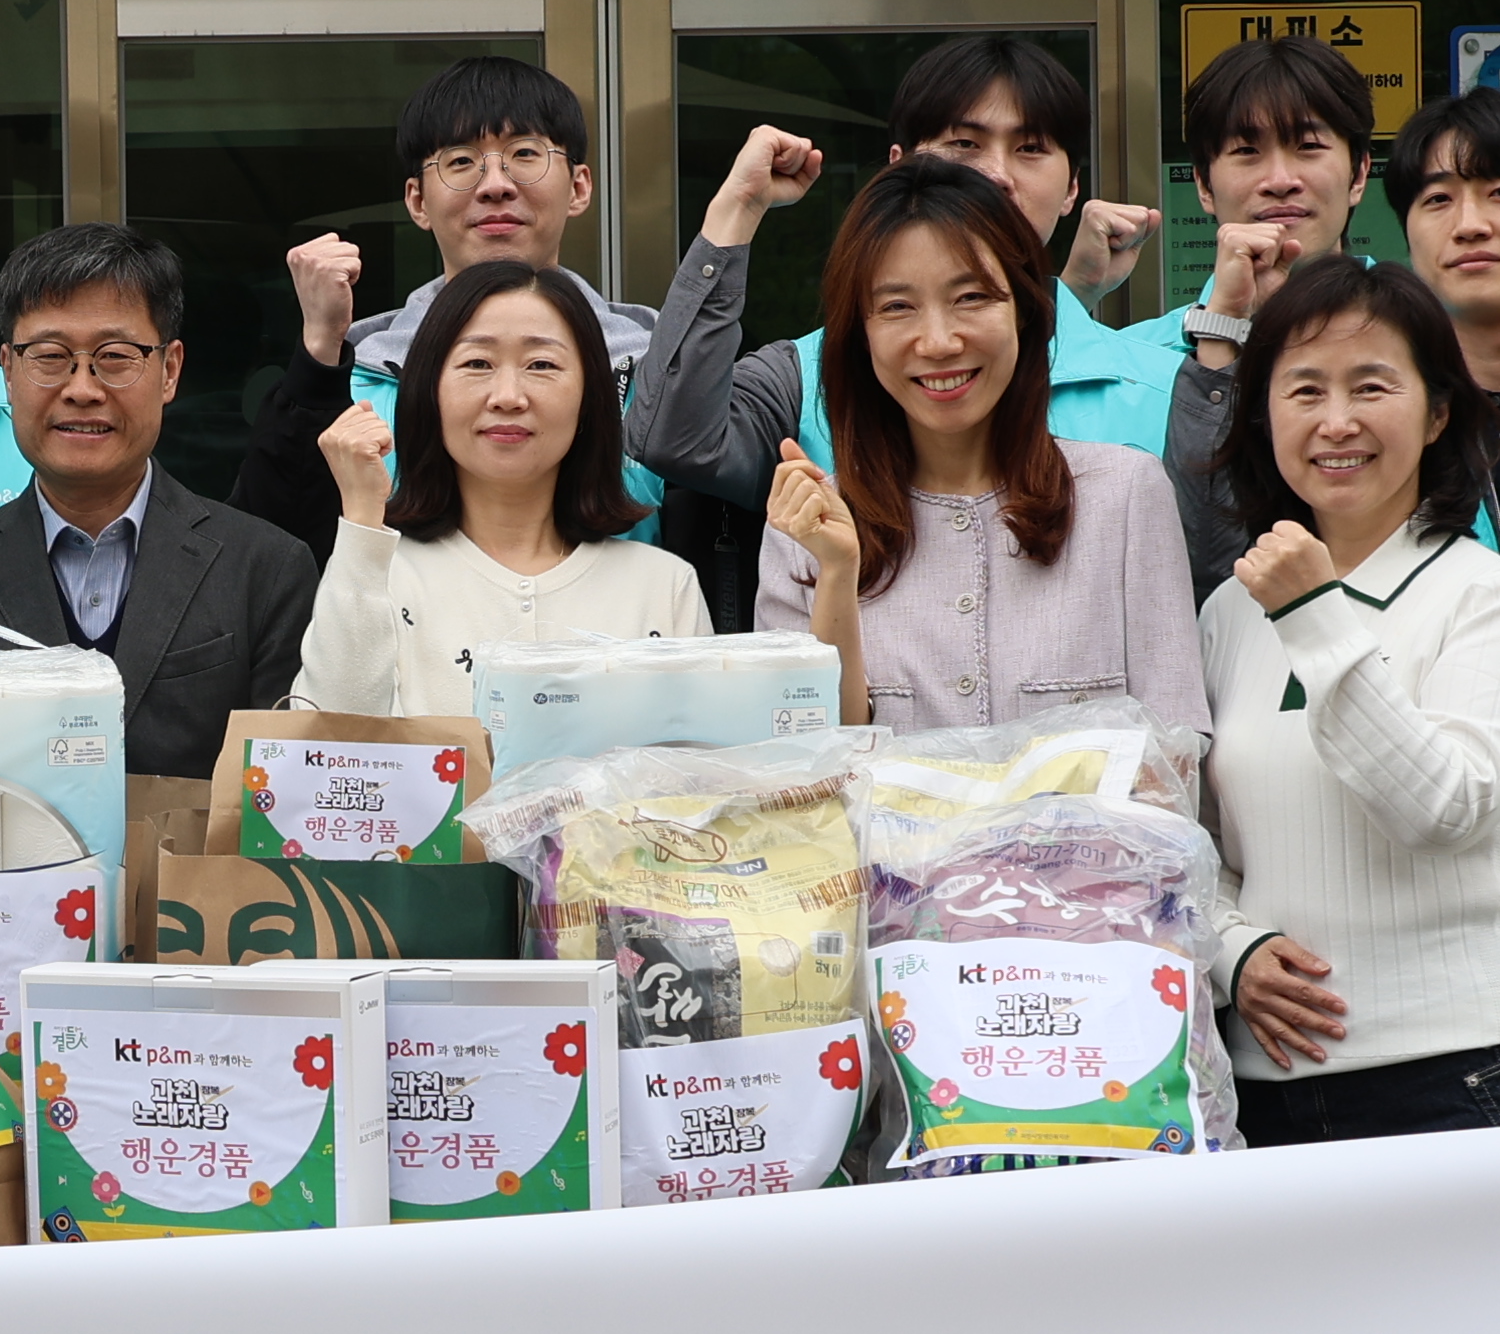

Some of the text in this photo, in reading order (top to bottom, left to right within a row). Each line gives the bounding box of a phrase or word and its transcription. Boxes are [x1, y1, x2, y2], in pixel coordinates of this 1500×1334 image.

[305, 750, 324, 767] kt
[304, 817, 399, 844] 행운경품
[958, 964, 1108, 985] kt p&m 함께하는
[996, 993, 1048, 1016] 과천
[976, 1013, 1081, 1037] 노래자랑
[115, 1038, 192, 1066] kt p&m
[453, 1045, 500, 1057] 함께하는
[961, 1045, 1107, 1078] 행운경품
[391, 1071, 443, 1096] 과천
[646, 1074, 722, 1099] kt p&m
[133, 1102, 228, 1130] 노래자랑
[681, 1105, 734, 1134] 과천
[387, 1131, 500, 1170] 운경품
[667, 1125, 765, 1160] 노래자랑
[121, 1138, 252, 1179] 행운경품
